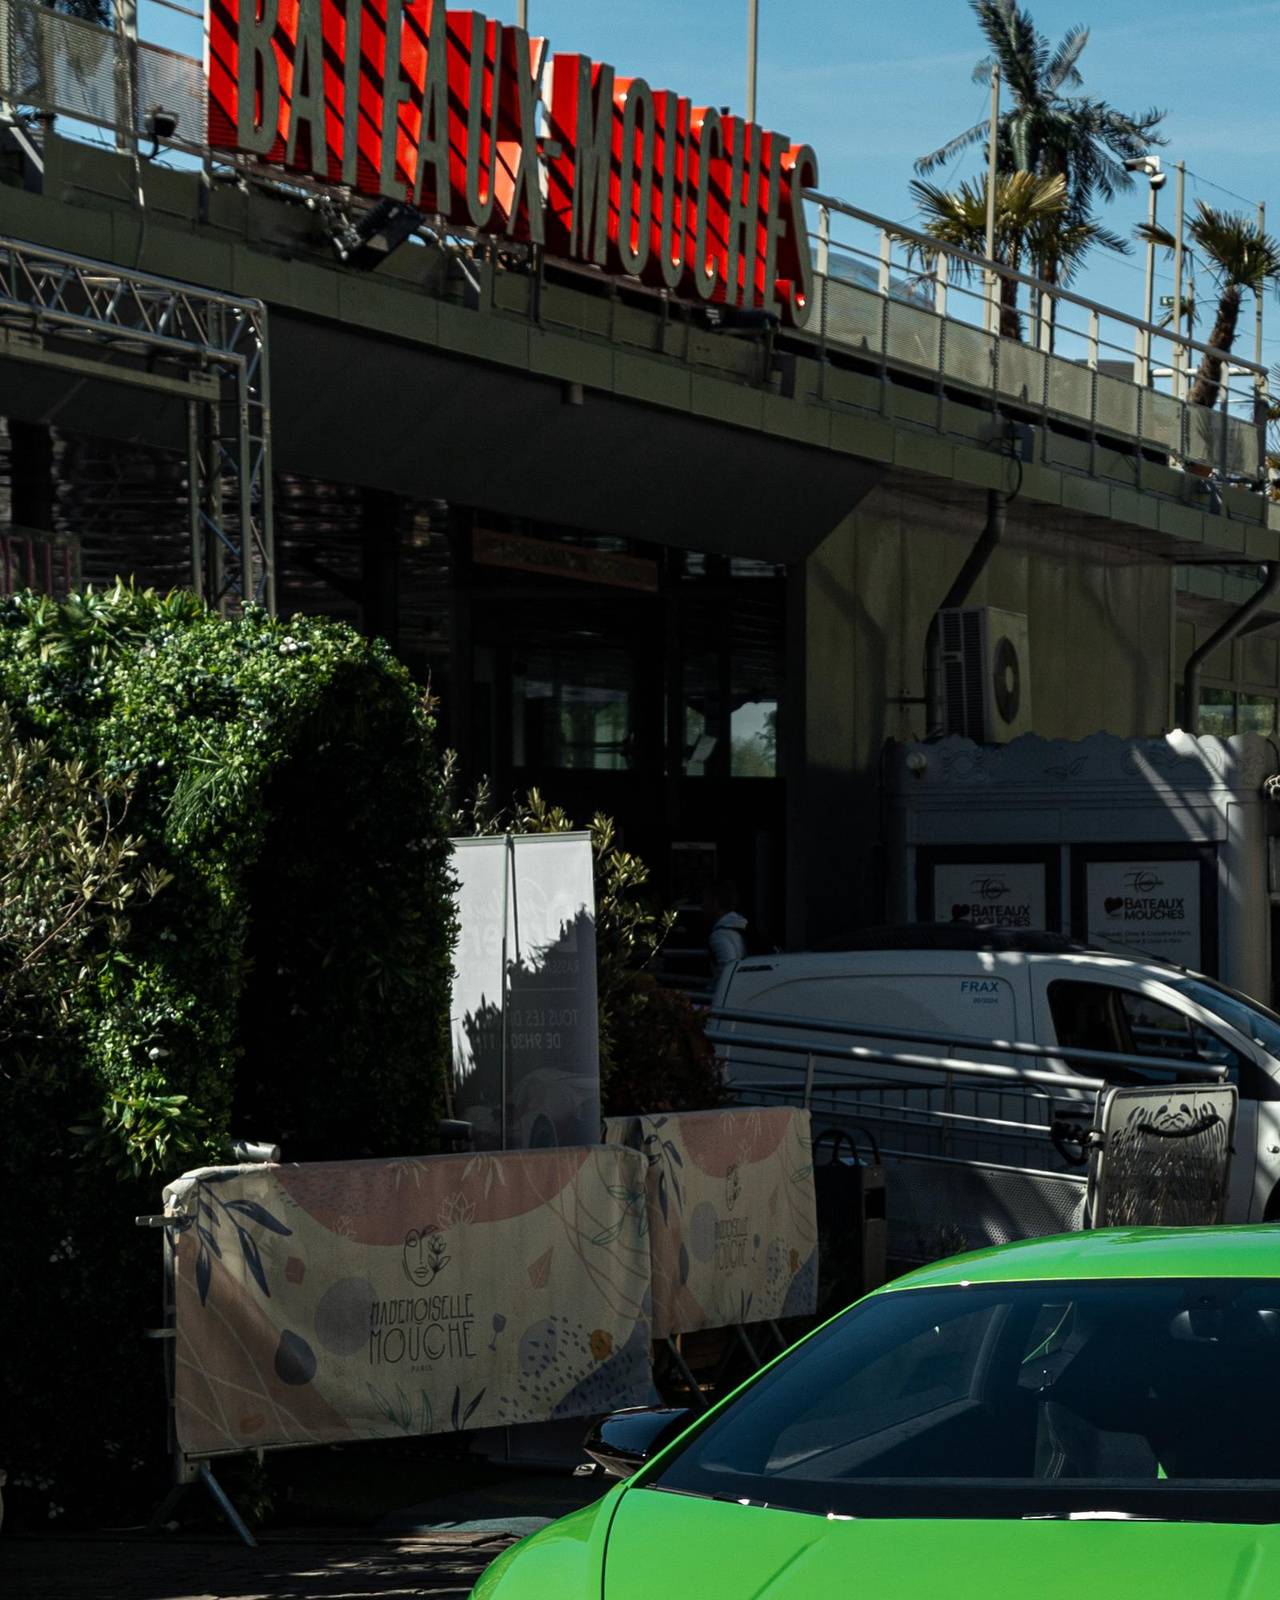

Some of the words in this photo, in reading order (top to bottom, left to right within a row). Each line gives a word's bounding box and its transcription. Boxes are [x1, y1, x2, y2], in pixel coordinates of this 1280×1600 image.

[1124, 897, 1184, 910] BATEAUX
[971, 904, 1031, 917] BATEAUX
[1124, 909, 1185, 920] MOUCHES
[960, 981, 999, 992] FRAX
[370, 1293, 475, 1326] MADEMOISELLE
[369, 1320, 477, 1365] MOUCHE
[411, 1364, 434, 1373] PARIS
